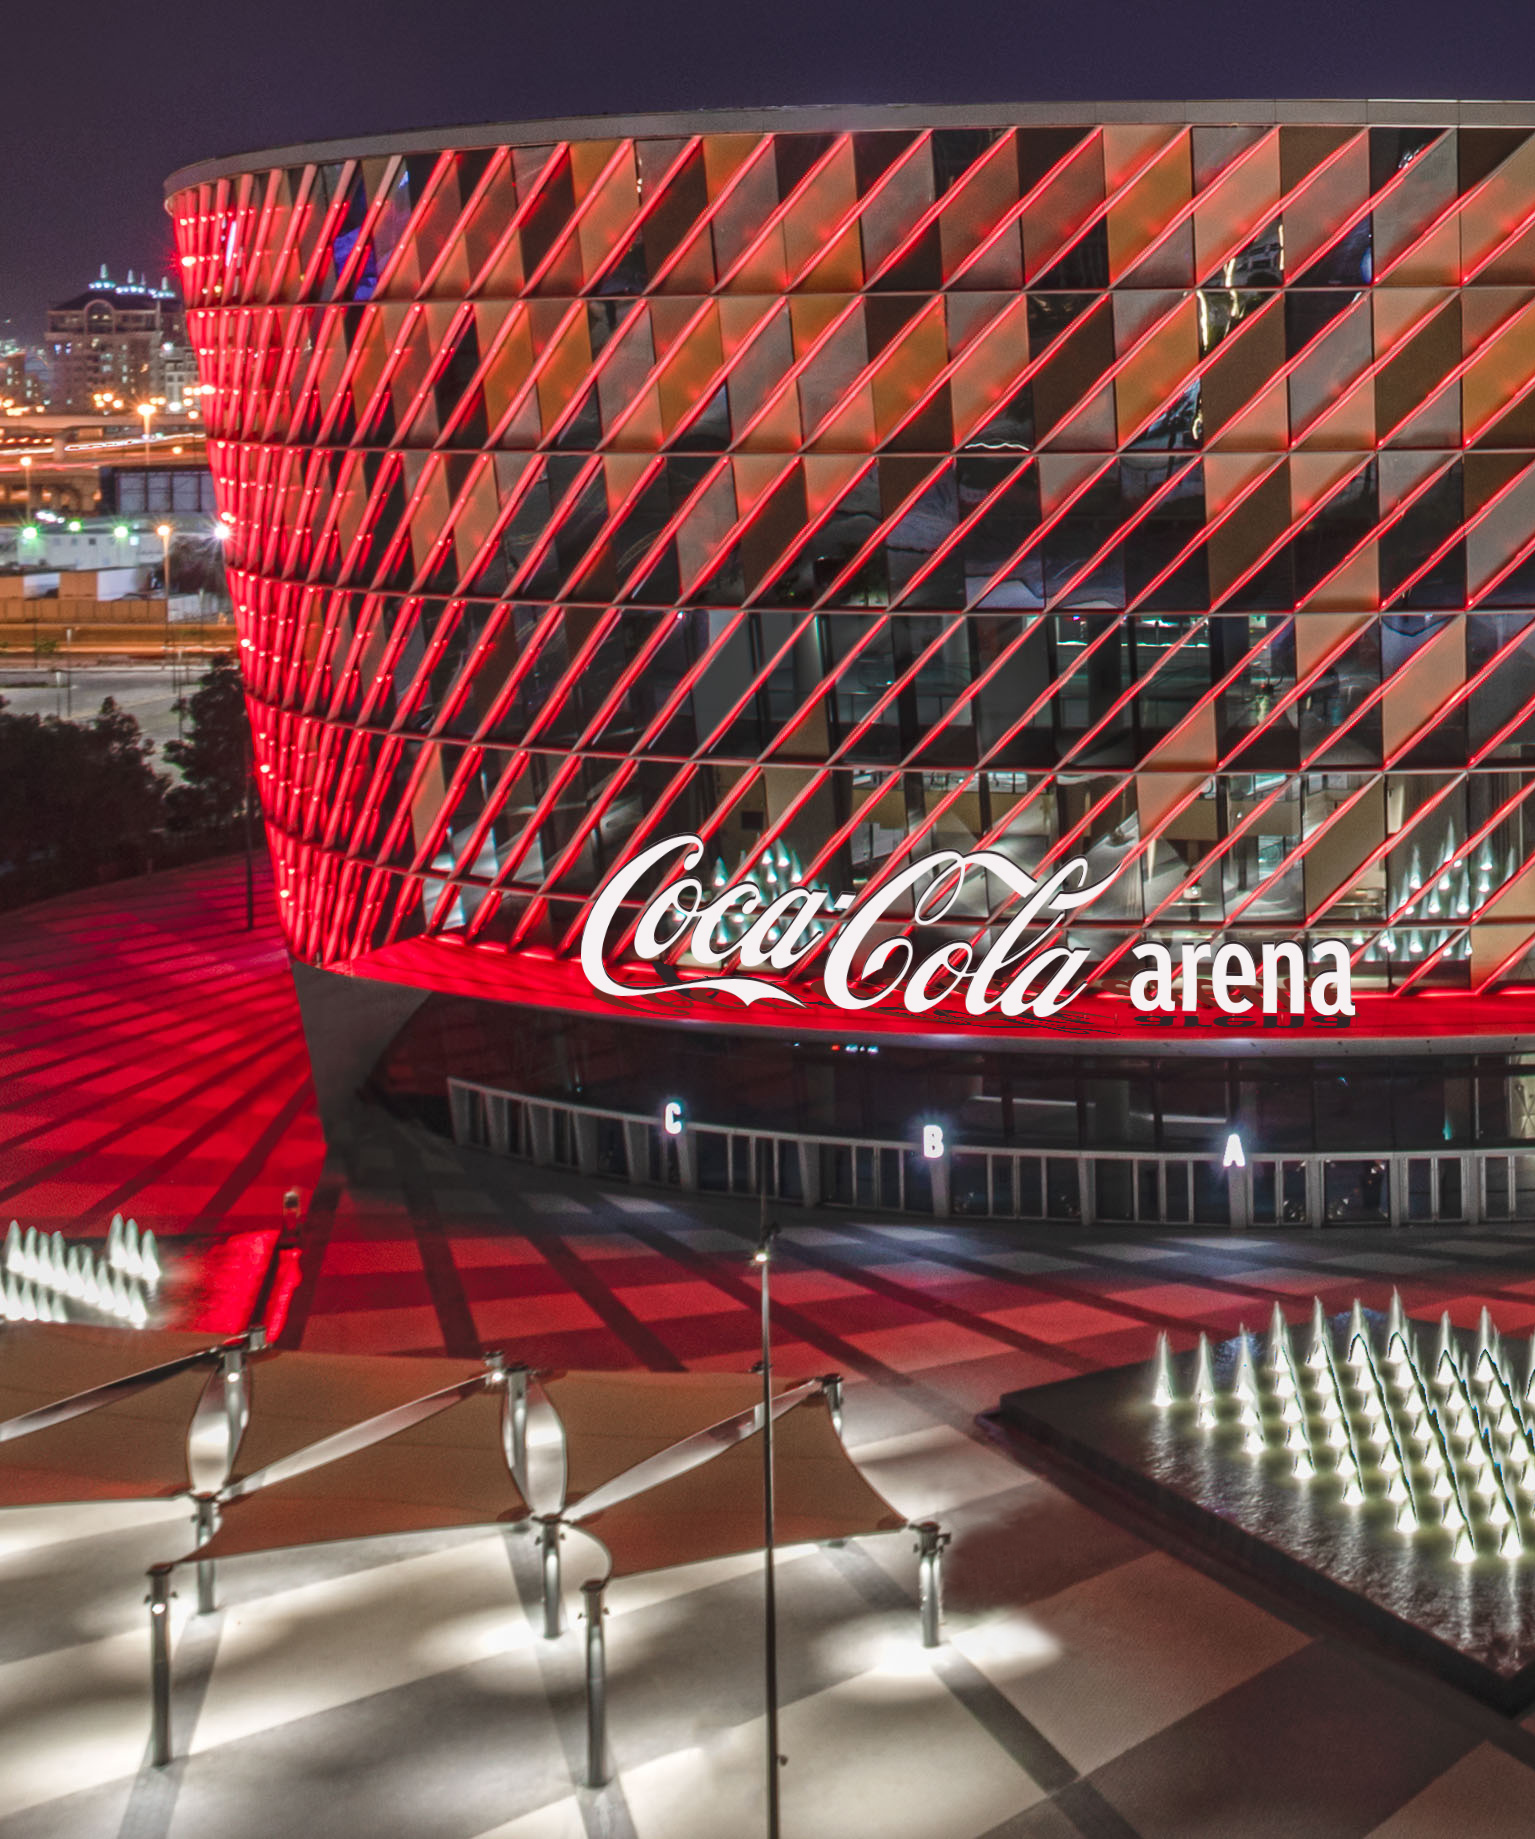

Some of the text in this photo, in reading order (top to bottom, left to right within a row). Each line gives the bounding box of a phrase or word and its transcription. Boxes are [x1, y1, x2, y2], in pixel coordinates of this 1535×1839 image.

[581, 832, 1356, 1017] Coca-Cola arena
[665, 1102, 682, 1135] C
[923, 1125, 944, 1158] B
[1223, 1133, 1246, 1167] A
